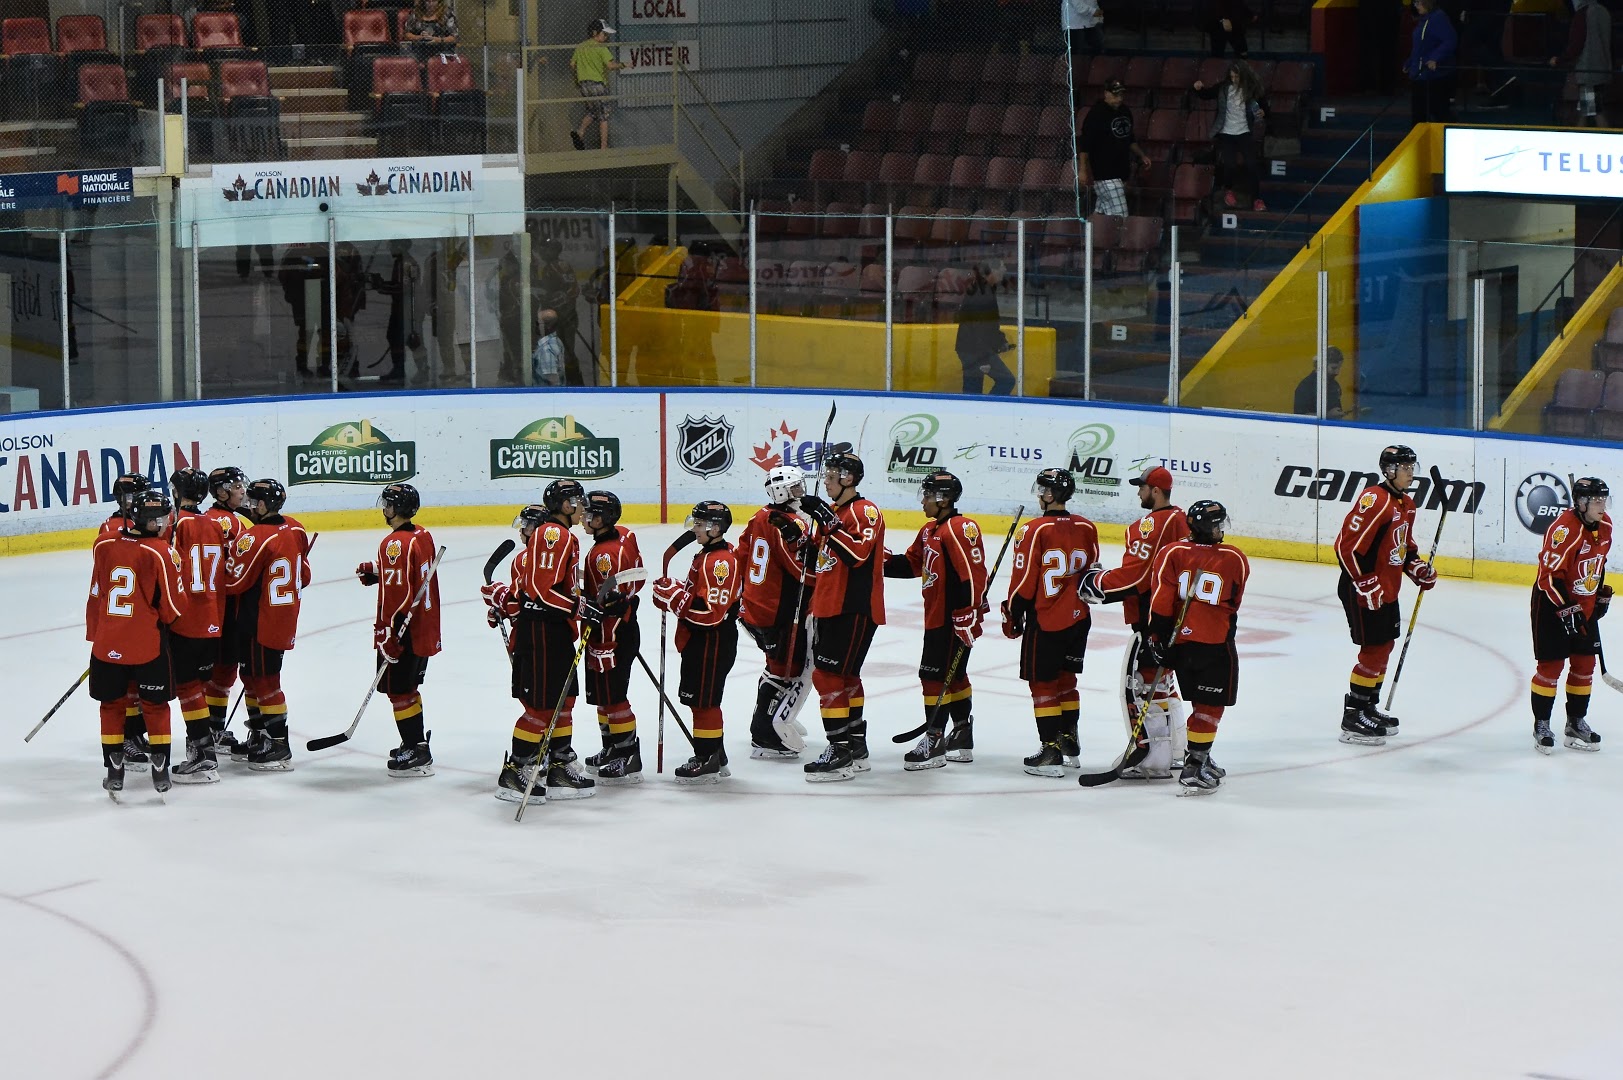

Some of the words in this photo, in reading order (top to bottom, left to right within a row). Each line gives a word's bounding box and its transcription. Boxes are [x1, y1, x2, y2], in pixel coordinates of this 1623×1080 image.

[632, 0, 686, 19] LOCAL
[1320, 107, 1336, 122] F
[1271, 160, 1286, 176] E
[82, 173, 118, 183] BANQUE
[82, 181, 130, 192] NATIONALE
[388, 170, 472, 194] CANADIAN
[254, 175, 341, 200] CANADIAN
[83, 195, 131, 204] FINANCIÈRE
[1222, 213, 1238, 229] D
[1111, 325, 1127, 341] B
[0, 434, 53, 451] OLSON
[690, 432, 724, 464] NHL
[498, 446, 612, 469] Cavendish
[888, 446, 938, 473] MD
[988, 446, 1043, 460] TELUS
[295, 450, 408, 475] Cavendish
[1068, 455, 1113, 477] MD
[1160, 458, 1212, 474] TELUS
[1074, 476, 1116, 485] ommunication
[1349, 515, 1363, 531] 5
[539, 552, 555, 569] 11
[970, 548, 982, 564] 9
[1542, 550, 1561, 569] 47
[189, 544, 222, 592] 17
[226, 556, 245, 578] 24
[384, 568, 403, 586] 71
[107, 566, 137, 617] 2
[707, 587, 730, 605] 26
[1178, 569, 1224, 606] 19
[817, 655, 839, 666] CCM
[1197, 684, 1223, 694] CCM
